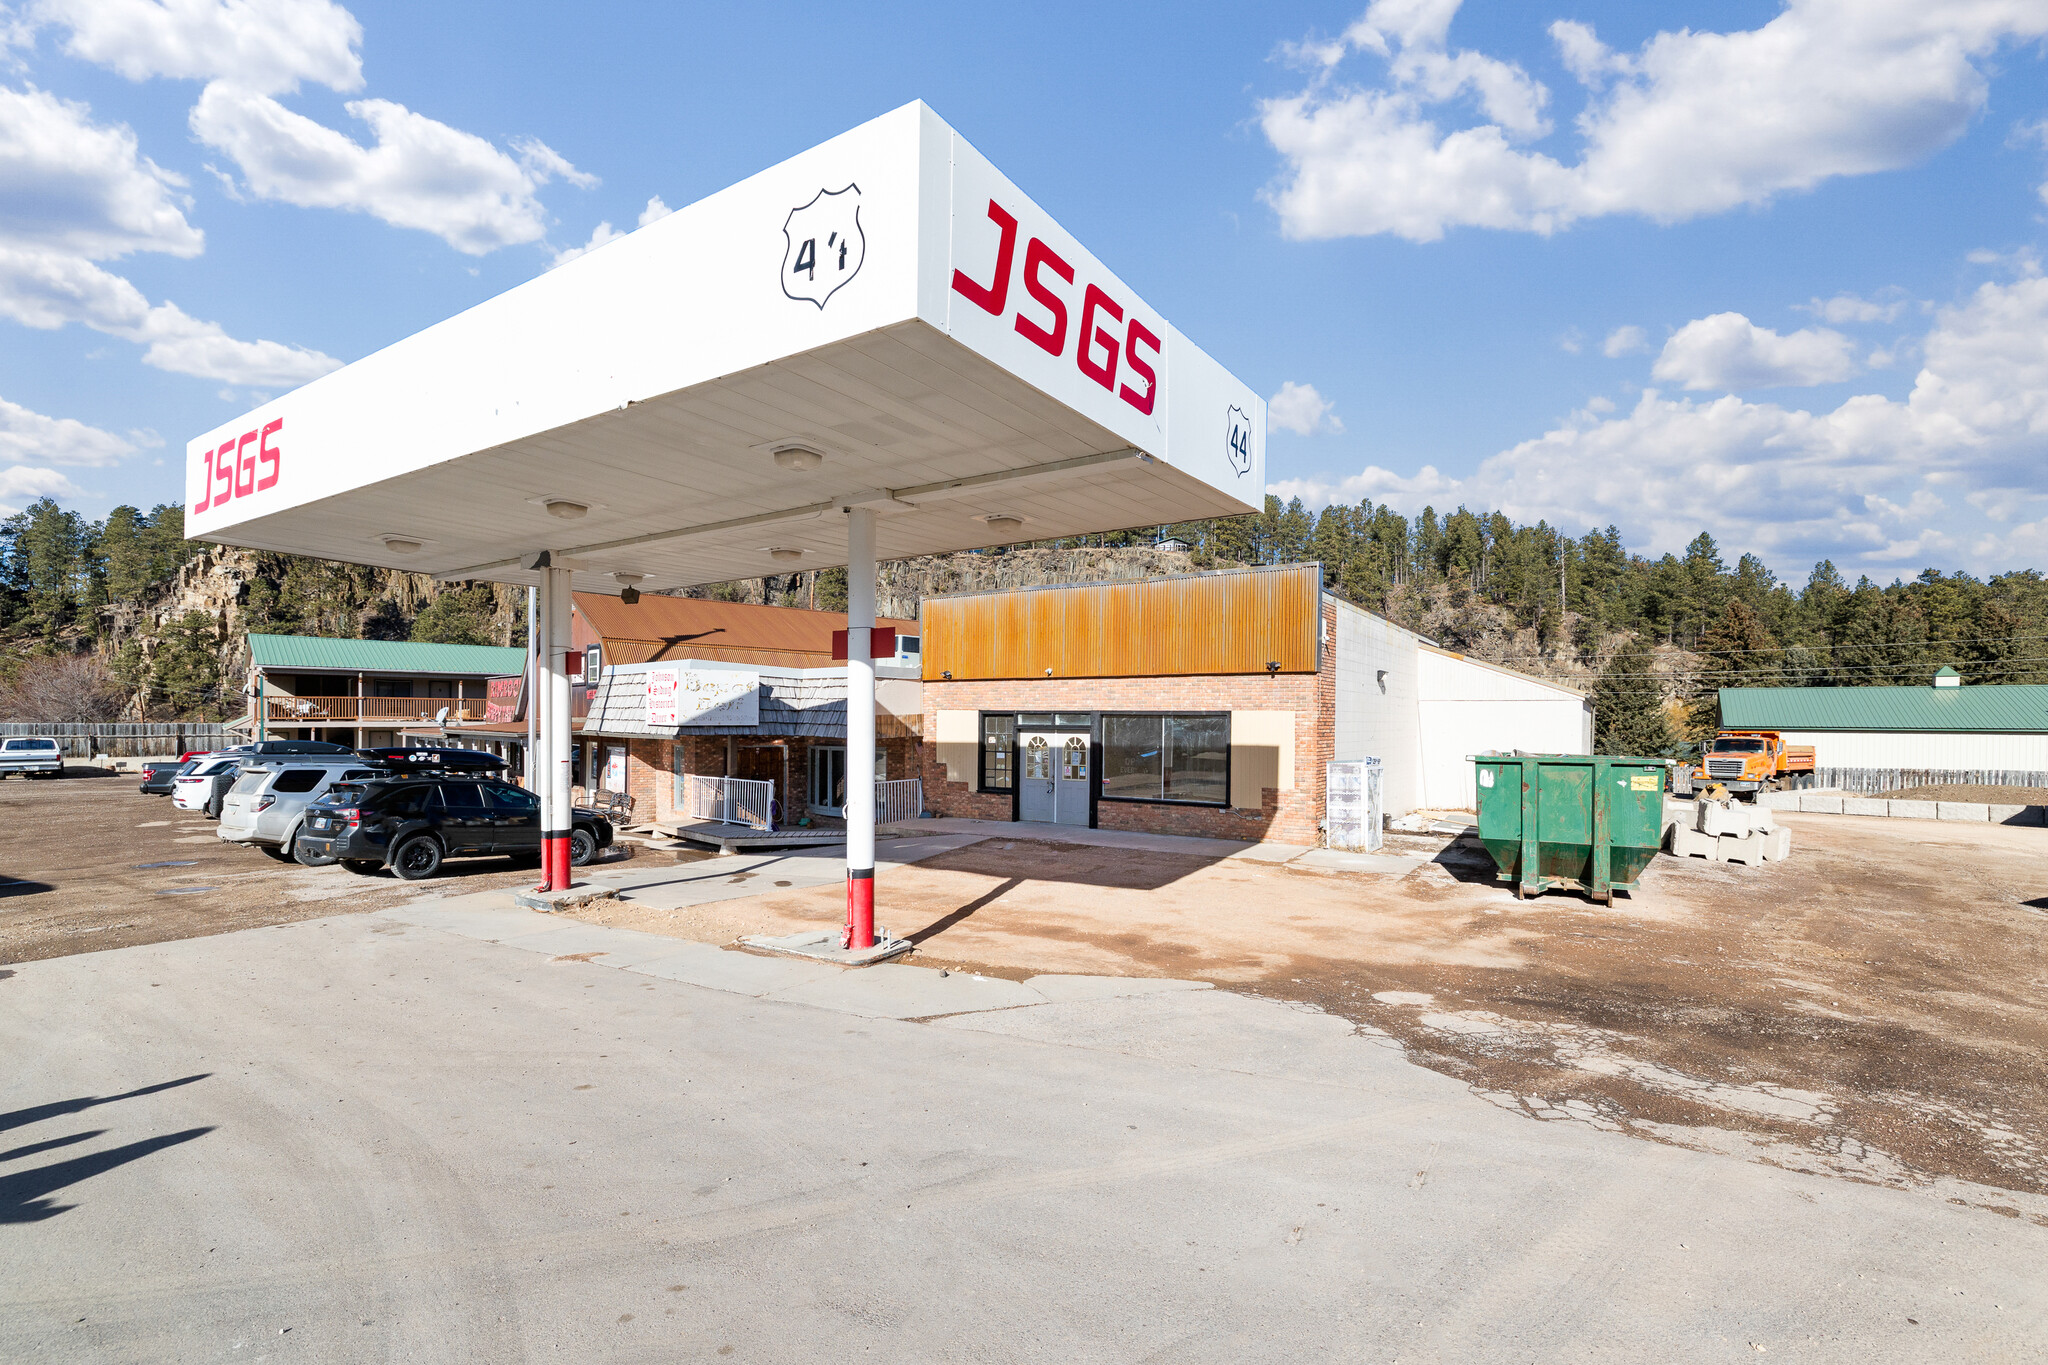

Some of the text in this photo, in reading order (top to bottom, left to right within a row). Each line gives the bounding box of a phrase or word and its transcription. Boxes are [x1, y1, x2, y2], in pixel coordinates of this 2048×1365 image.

[952, 198, 1162, 416] JSGS
[194, 416, 283, 515] JSGS
[1230, 424, 1248, 463] 44
[490, 679, 522, 698] RIMROC
